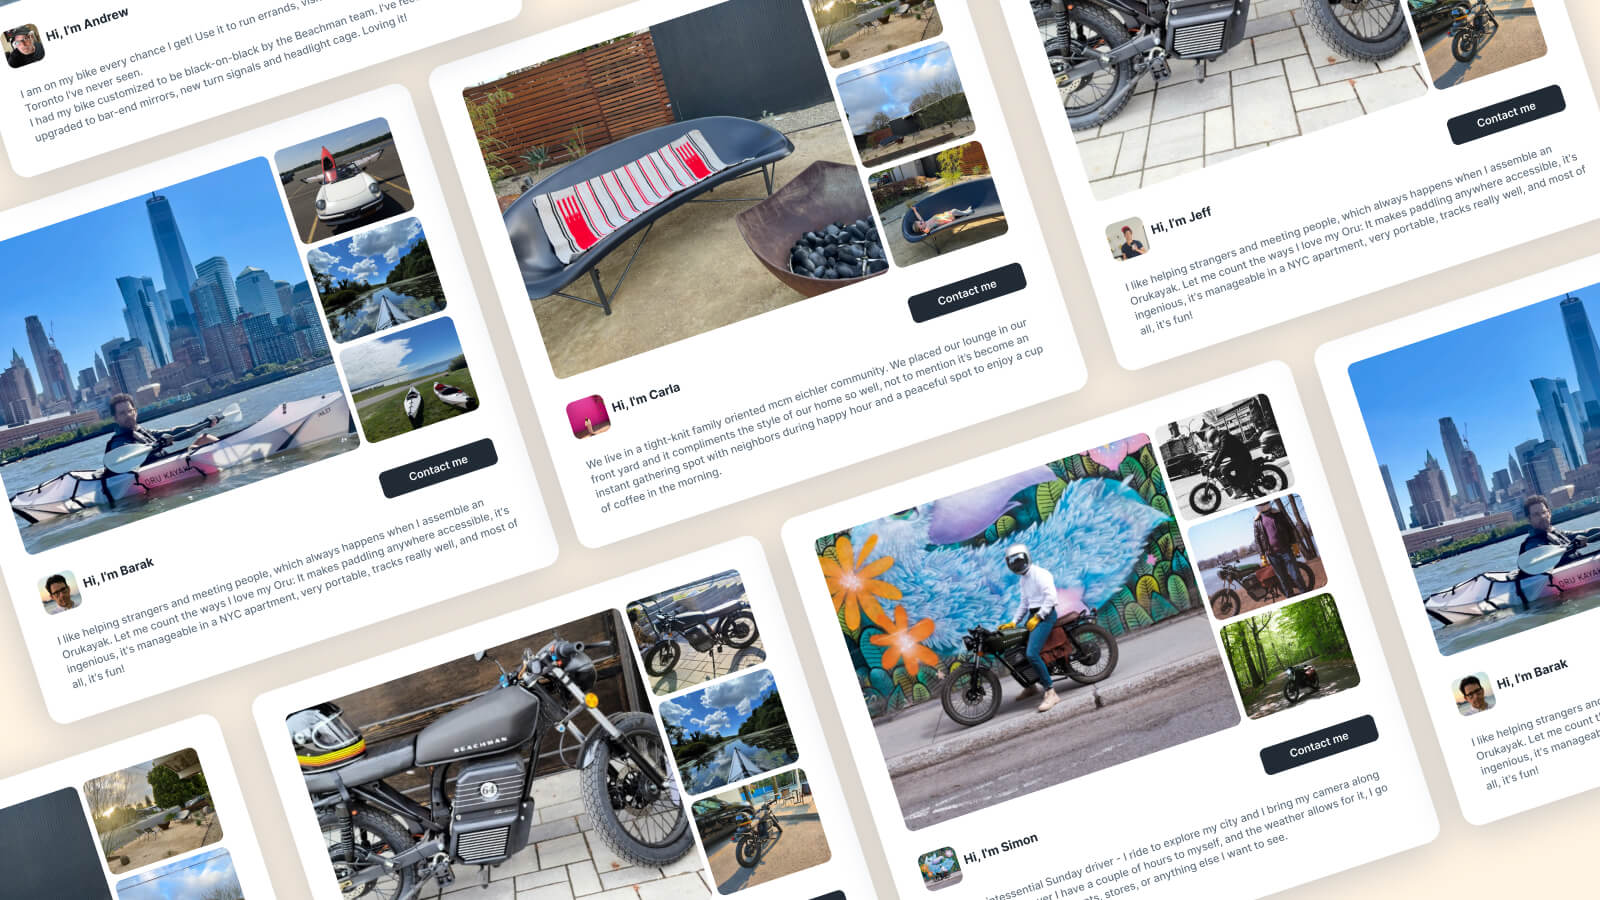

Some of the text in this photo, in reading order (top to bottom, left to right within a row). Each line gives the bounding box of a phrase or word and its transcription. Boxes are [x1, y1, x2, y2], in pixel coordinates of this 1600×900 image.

[44, 6, 129, 43] Hi, I'm Andrew
[25, 85, 43, 97] am
[42, 80, 58, 91] on
[57, 75, 74, 87] my
[74, 67, 98, 81] bike
[98, 57, 127, 73] every
[128, 44, 167, 63] chance
[172, 33, 194, 51] get!
[193, 28, 216, 42] Use
[215, 24, 225, 35] it
[224, 21, 238, 32] to
[237, 15, 257, 28] run
[256, 2, 300, 21] errands,
[23, 69, 144, 113] Toronto I've never seen.
[33, 11, 408, 143] upgraded to bar-end mirrors, new turn signals and headlight cage. Loving it!
[1476, 102, 1537, 128] Contact me
[1129, 283, 1181, 306] Orukayak.
[1180, 276, 1200, 289] Let
[1199, 271, 1217, 283] me
[1217, 260, 1249, 277] count
[1247, 255, 1267, 267] the
[1266, 245, 1295, 261] ways
[1300, 236, 1323, 250] love
[1323, 230, 1340, 243] my
[1340, 223, 1364, 237] Oru:
[1363, 219, 1374, 229] It
[1373, 208, 1408, 226] makes
[1408, 194, 1454, 217] paddling
[1453, 177, 1504, 200] anywhere
[1504, 159, 1562, 184] accessible,
[1560, 152, 1578, 165] it's
[1149, 204, 1212, 235] Hi, I'm Jeff
[936, 279, 998, 306] Contact me
[1139, 309, 1194, 336] all, it's fun!
[584, 457, 603, 470] We
[603, 451, 623, 464] live
[622, 447, 635, 458] in
[643, 428, 691, 451] tight-knit
[691, 418, 722, 435] family
[723, 403, 767, 425] oriented
[767, 395, 794, 411] mcm
[793, 383, 828, 402] eichler
[829, 365, 889, 390] community.
[888, 358, 907, 370] We
[907, 344, 943, 367] placed
[943, 340, 961, 353] our
[961, 328, 998, 347] lounge
[997, 325, 1009, 335] in
[1009, 318, 1027, 331] our
[610, 382, 682, 413] Hi, I'm Carla
[407, 455, 469, 481] Contact me
[600, 468, 723, 514] of coffee in the morning.
[81, 556, 155, 589] Hi, I'm Barak
[65, 651, 119, 674] ingenious,
[118, 644, 136, 657] it's
[135, 624, 199, 652] manageable
[197, 620, 210, 631] in
[218, 608, 243, 624] NYC
[243, 591, 300, 616] apartment,
[299, 583, 323, 597] very
[323, 569, 371, 592] portable,
[370, 557, 404, 574] tracks
[404, 547, 432, 563] really
[433, 538, 458, 553] well,
[458, 530, 479, 546] and
[479, 522, 507, 539] most
[506, 516, 518, 530] of
[71, 663, 126, 689] all, it's fun!
[1495, 658, 1569, 690] Hi, I'm Barak
[453, 736, 508, 753] BEACHMAN
[1288, 732, 1350, 758] Contact me
[1475, 715, 1594, 761] Orukayak. Let me count
[1485, 764, 1540, 791] all, it's fun!
[1044, 867, 1083, 887] Sunday
[1084, 857, 1114, 874] driver
[1128, 846, 1150, 860] ride
[1149, 842, 1162, 852] to
[1162, 829, 1201, 848] explore
[1201, 823, 1218, 836] my
[1218, 816, 1238, 830] city
[1239, 808, 1260, 823] and
[1265, 799, 1294, 814] bring
[1294, 793, 1310, 805] my
[1311, 780, 1351, 799] camera
[1351, 770, 1381, 787] along
[962, 833, 1040, 865] Hi, I'm Simon
[1103, 882, 1140, 899] stores,
[1139, 876, 1151, 887] or
[1152, 862, 1198, 883] anything
[1198, 854, 1221, 868] else
[1225, 842, 1253, 859] want
[1252, 840, 1265, 850] to
[1265, 833, 1289, 846] see.
